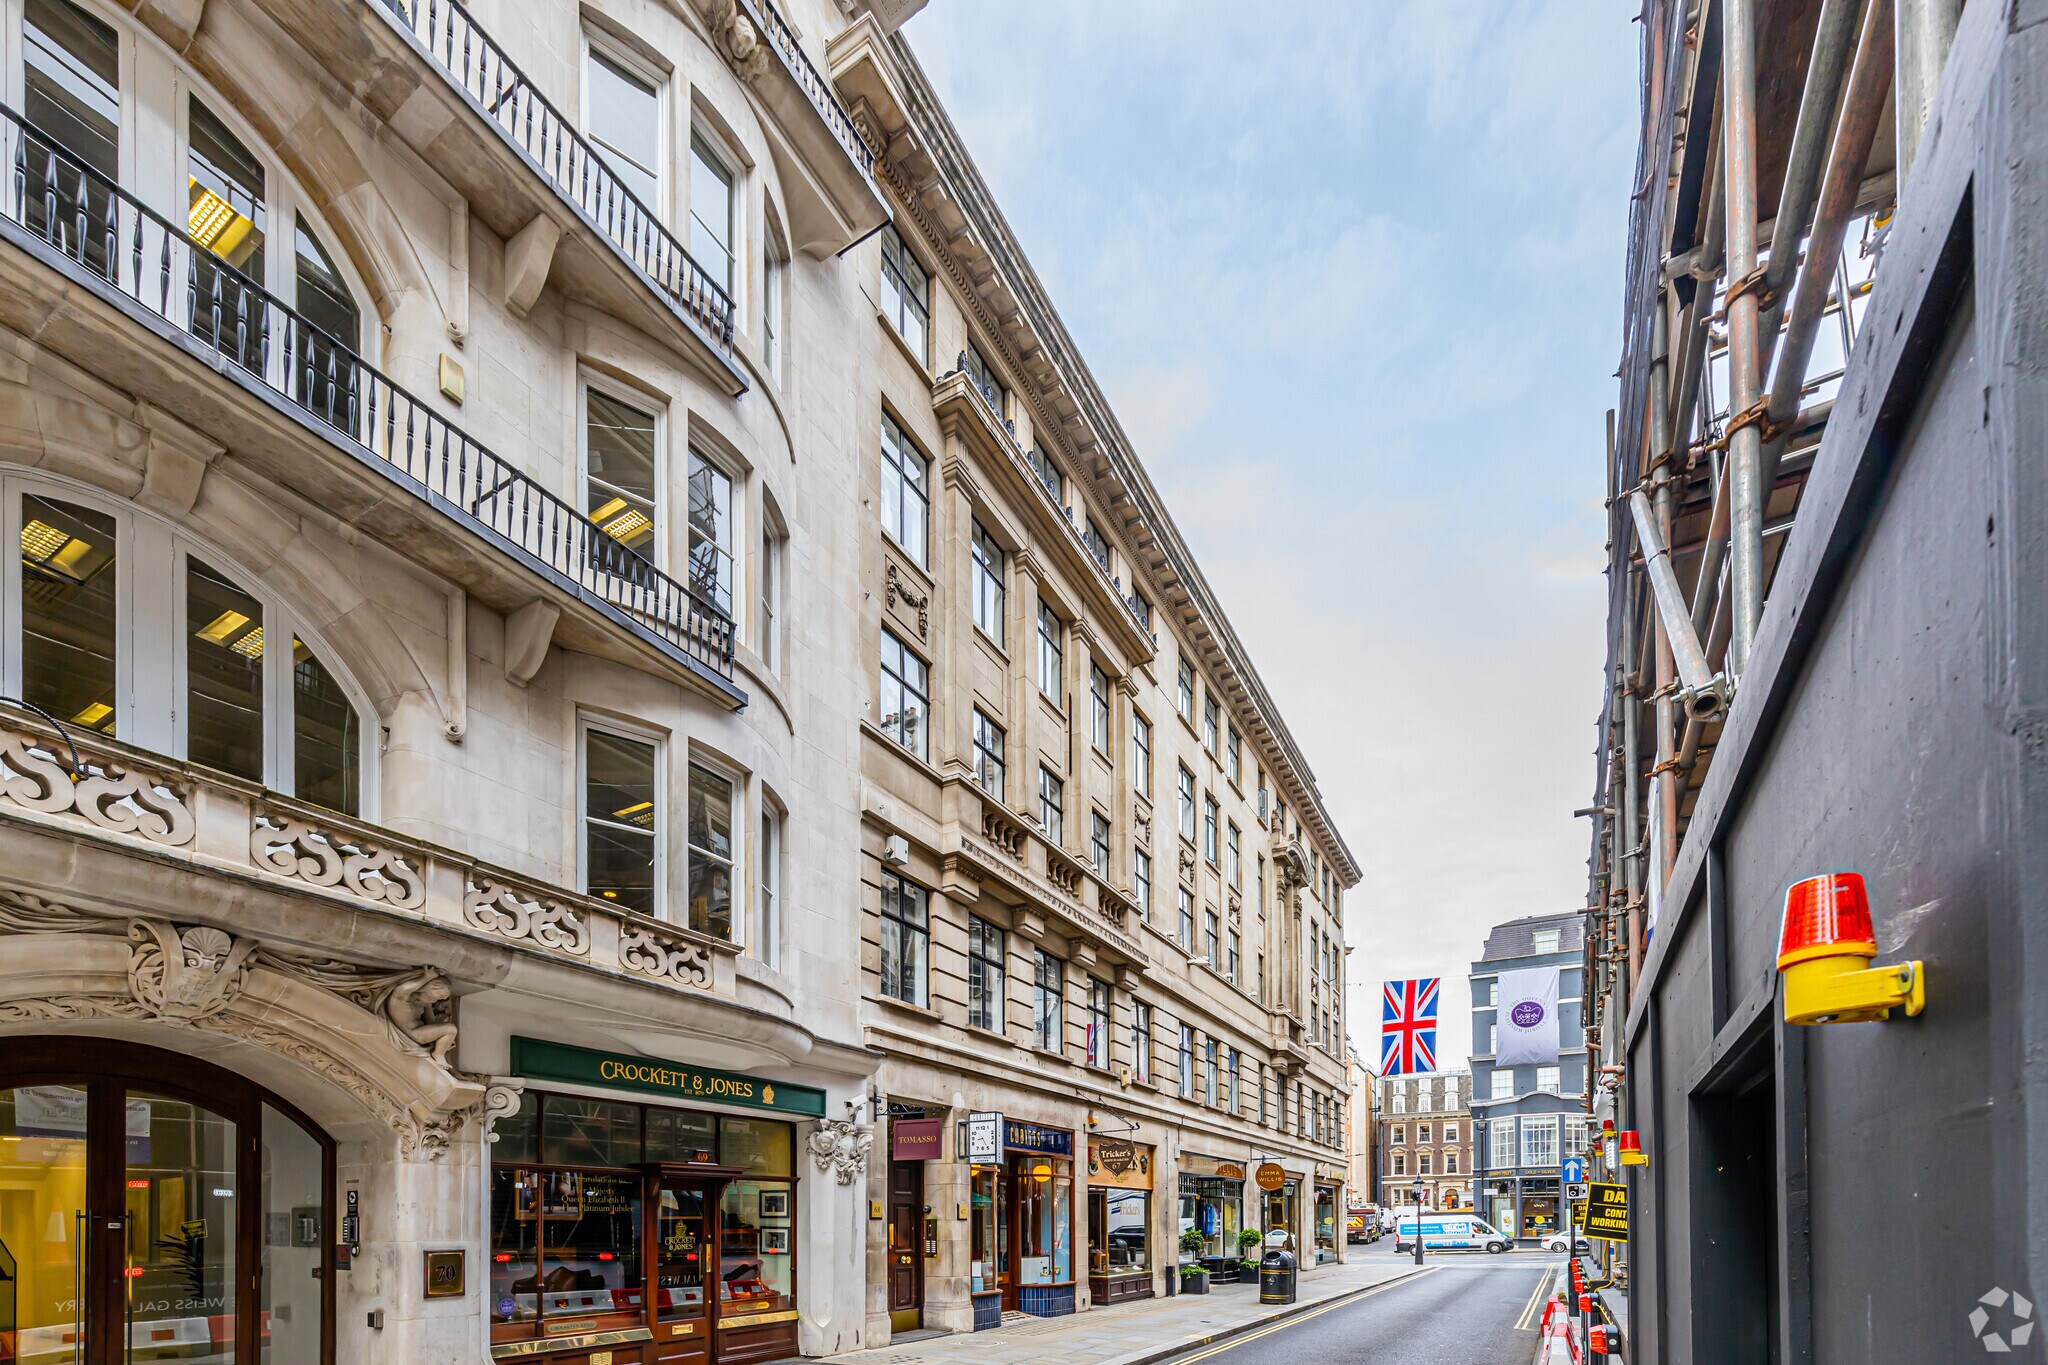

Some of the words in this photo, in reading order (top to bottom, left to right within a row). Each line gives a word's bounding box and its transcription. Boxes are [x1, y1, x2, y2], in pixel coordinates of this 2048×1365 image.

[600, 1060, 688, 1088] CROCKETT
[692, 1075, 703, 1090] &
[705, 1077, 753, 1097] JONES
[898, 1135, 937, 1144] TOMASSO
[1010, 1127, 1041, 1147] CUBITTS
[697, 1152, 708, 1162] 69
[1101, 1149, 1131, 1158] Tricker's
[1111, 1162, 1121, 1170] 67
[588, 1195, 619, 1204] Elizabeth
[664, 1237, 696, 1245] CROCKETT
[435, 1265, 456, 1281] 70
